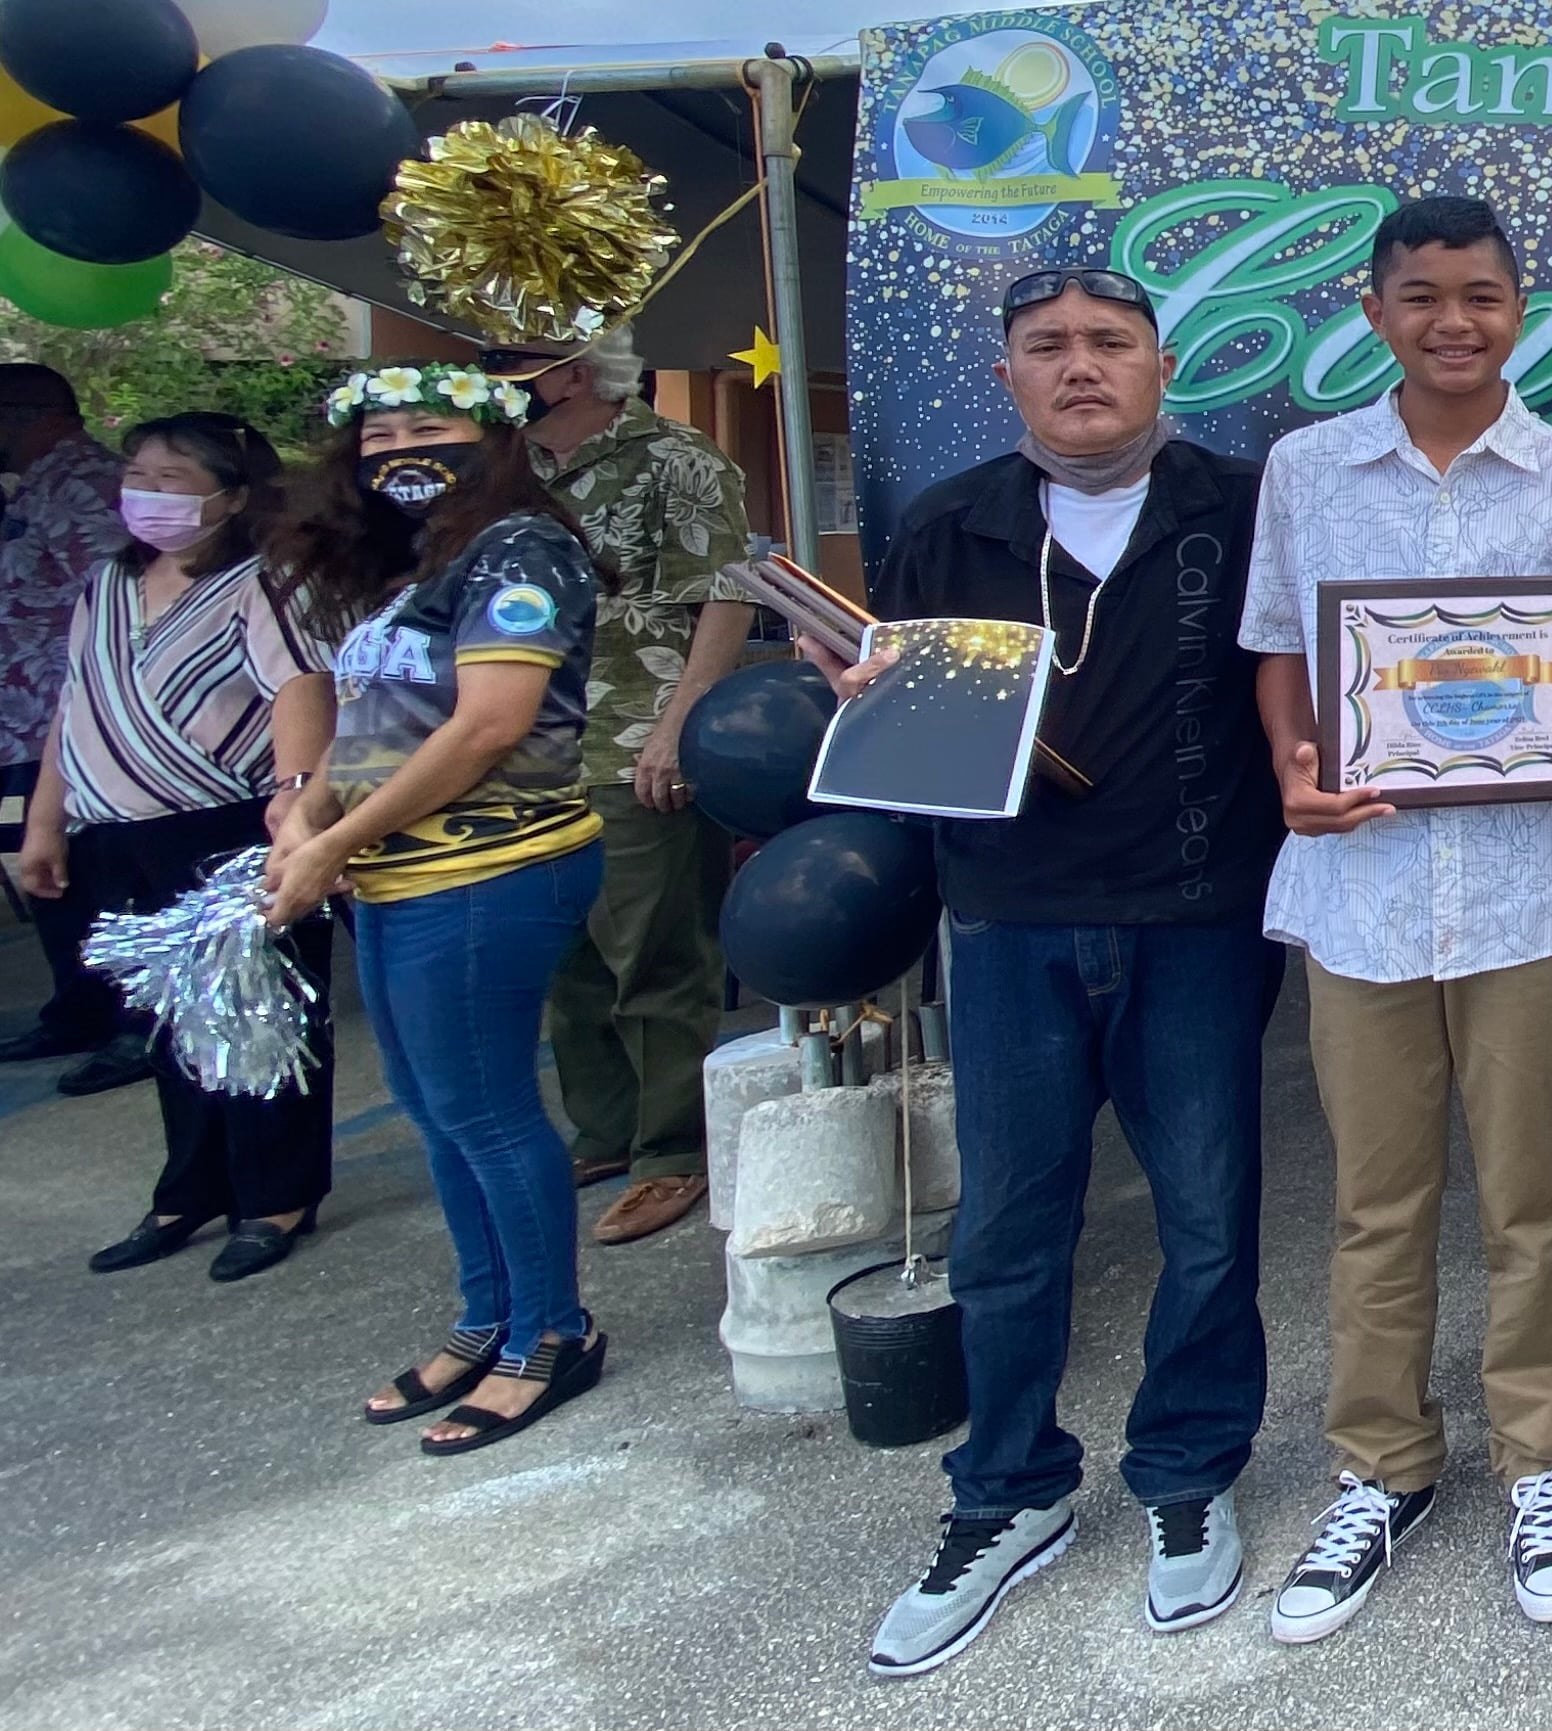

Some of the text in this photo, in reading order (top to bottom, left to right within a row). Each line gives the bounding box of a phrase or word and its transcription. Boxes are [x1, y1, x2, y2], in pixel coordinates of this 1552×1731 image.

[882, 15, 1117, 113] TANAPAG MIDDLE SCHOOL
[920, 182, 1057, 202] Empowering the Future
[903, 208, 1070, 255] HOME OF THE TATAGA
[1174, 532, 1224, 669] Calvin
[1387, 632, 1450, 645] Certificate
[1443, 646, 1484, 656] Awarded
[1174, 675, 1220, 781] Klein
